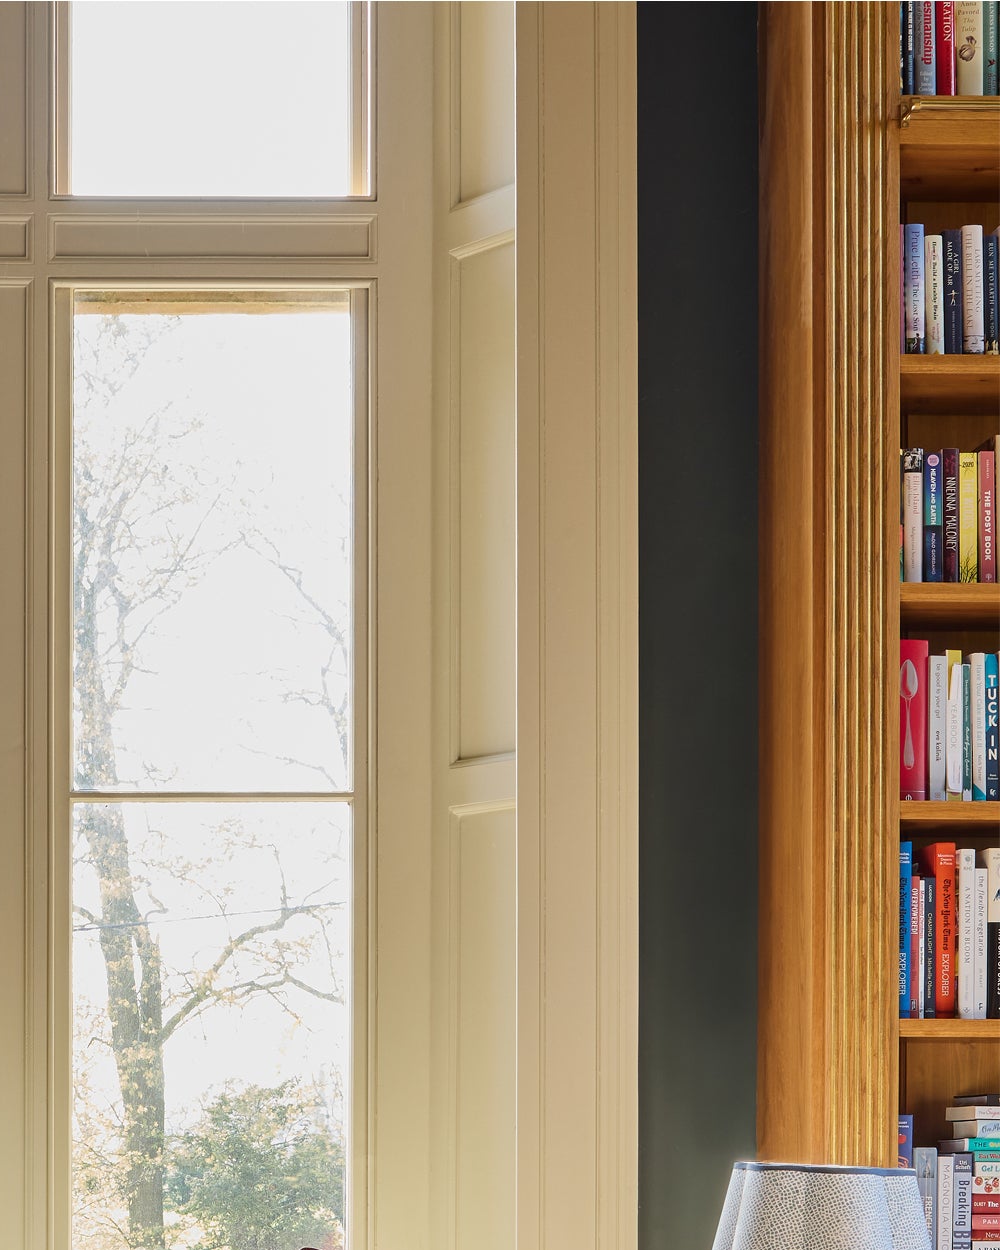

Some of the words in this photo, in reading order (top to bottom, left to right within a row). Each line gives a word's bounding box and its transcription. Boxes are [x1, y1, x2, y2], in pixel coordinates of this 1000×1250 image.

[922, 1, 933, 65] esmanship
[943, 2, 951, 41] RATION
[911, 231, 920, 254] Prue
[911, 256, 920, 280] Leith
[947, 264, 953, 272] OF
[989, 261, 994, 270] ME
[989, 272, 994, 281] TO
[966, 275, 972, 285] IN
[946, 477, 956, 512] NNENNA
[946, 515, 957, 551] MALONEY
[987, 674, 998, 727] TUCK
[988, 735, 998, 761] IN
[943, 879, 951, 893] The
[943, 894, 951, 909] New
[941, 910, 951, 927] York
[943, 929, 951, 950] Times
[965, 926, 971, 935] IN
[941, 953, 949, 997] EXPLORER
[941, 1164, 950, 1223] MAGNOLIA
[955, 1180, 970, 1226] Breaking
